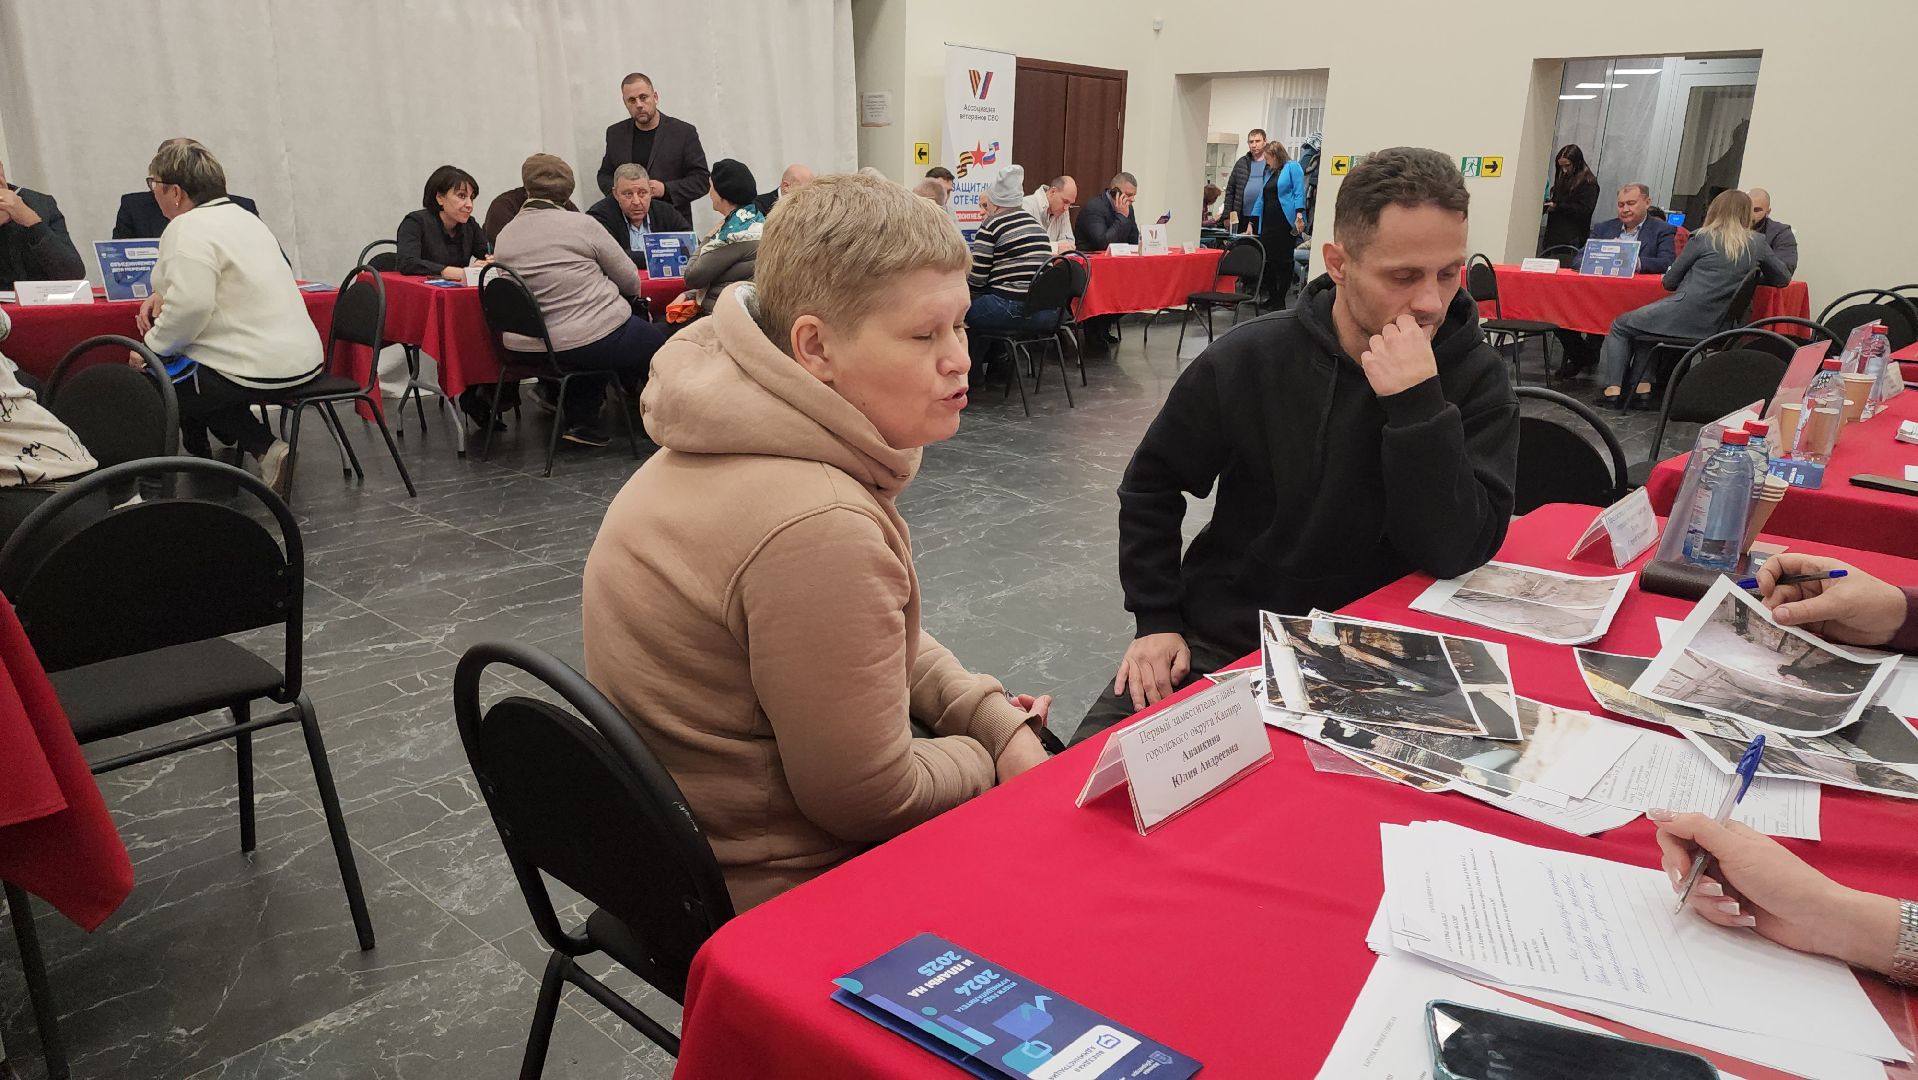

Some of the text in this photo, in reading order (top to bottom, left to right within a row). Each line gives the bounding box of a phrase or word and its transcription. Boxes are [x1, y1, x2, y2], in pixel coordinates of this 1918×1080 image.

[954, 195, 979, 205] ОТЕЧЕ
[1138, 718, 1171, 744] Первый
[1172, 697, 1216, 726] заместитель
[1145, 702, 1242, 762] городского округа Кашира
[1171, 743, 1239, 788] Юлия Андреевна
[907, 959, 975, 997] И ПЛАНЫ НА
[918, 950, 961, 976] 2025
[953, 969, 1000, 996] 2024
